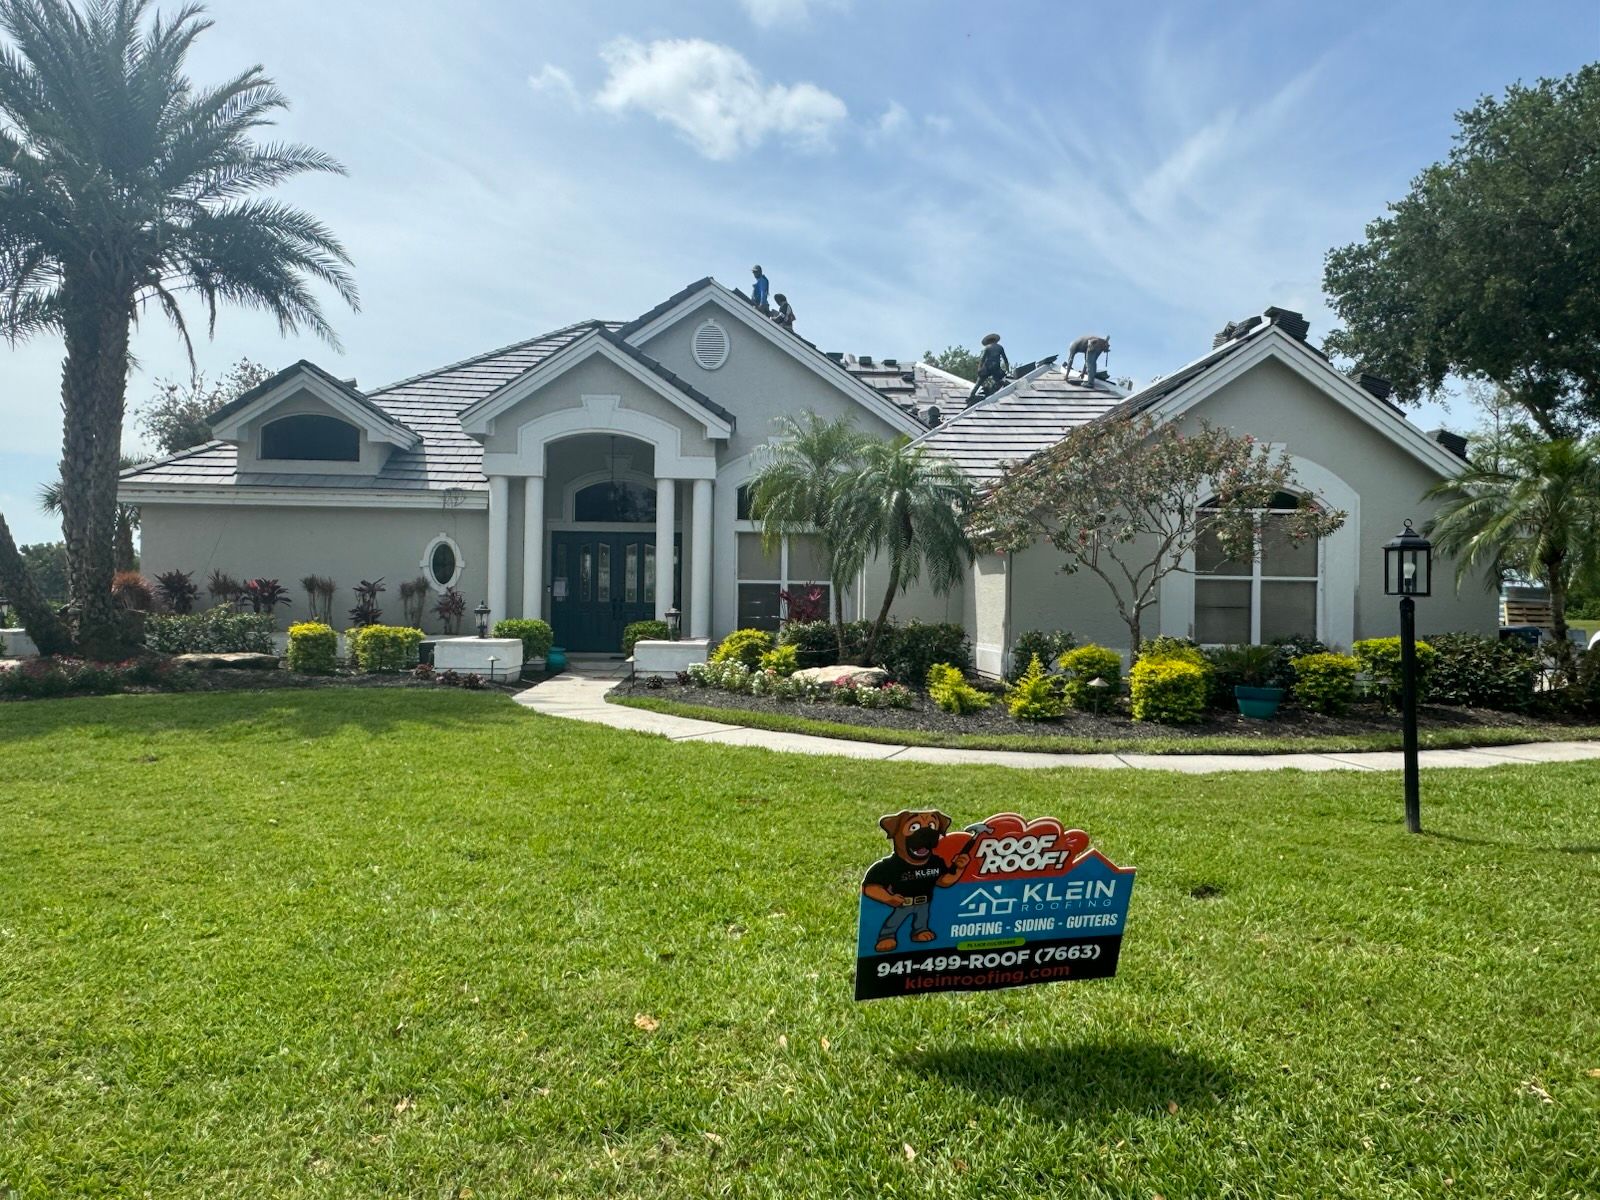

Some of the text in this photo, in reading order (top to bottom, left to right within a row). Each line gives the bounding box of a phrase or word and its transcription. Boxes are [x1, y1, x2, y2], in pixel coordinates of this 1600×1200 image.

[976, 834, 1057, 858] ROOF
[915, 868, 940, 877] KLEIN
[980, 850, 1069, 874] ROOF!
[1022, 879, 1116, 902] KLEIN
[1021, 900, 1112, 912] ROOFING
[950, 922, 1002, 938] ROOFING
[1013, 917, 1055, 932] SIDING
[1066, 913, 1118, 929] GUTTERS
[876, 944, 1101, 977] 941-499-ROOF (7663)
[904, 965, 1070, 990] kleinroofing.com
